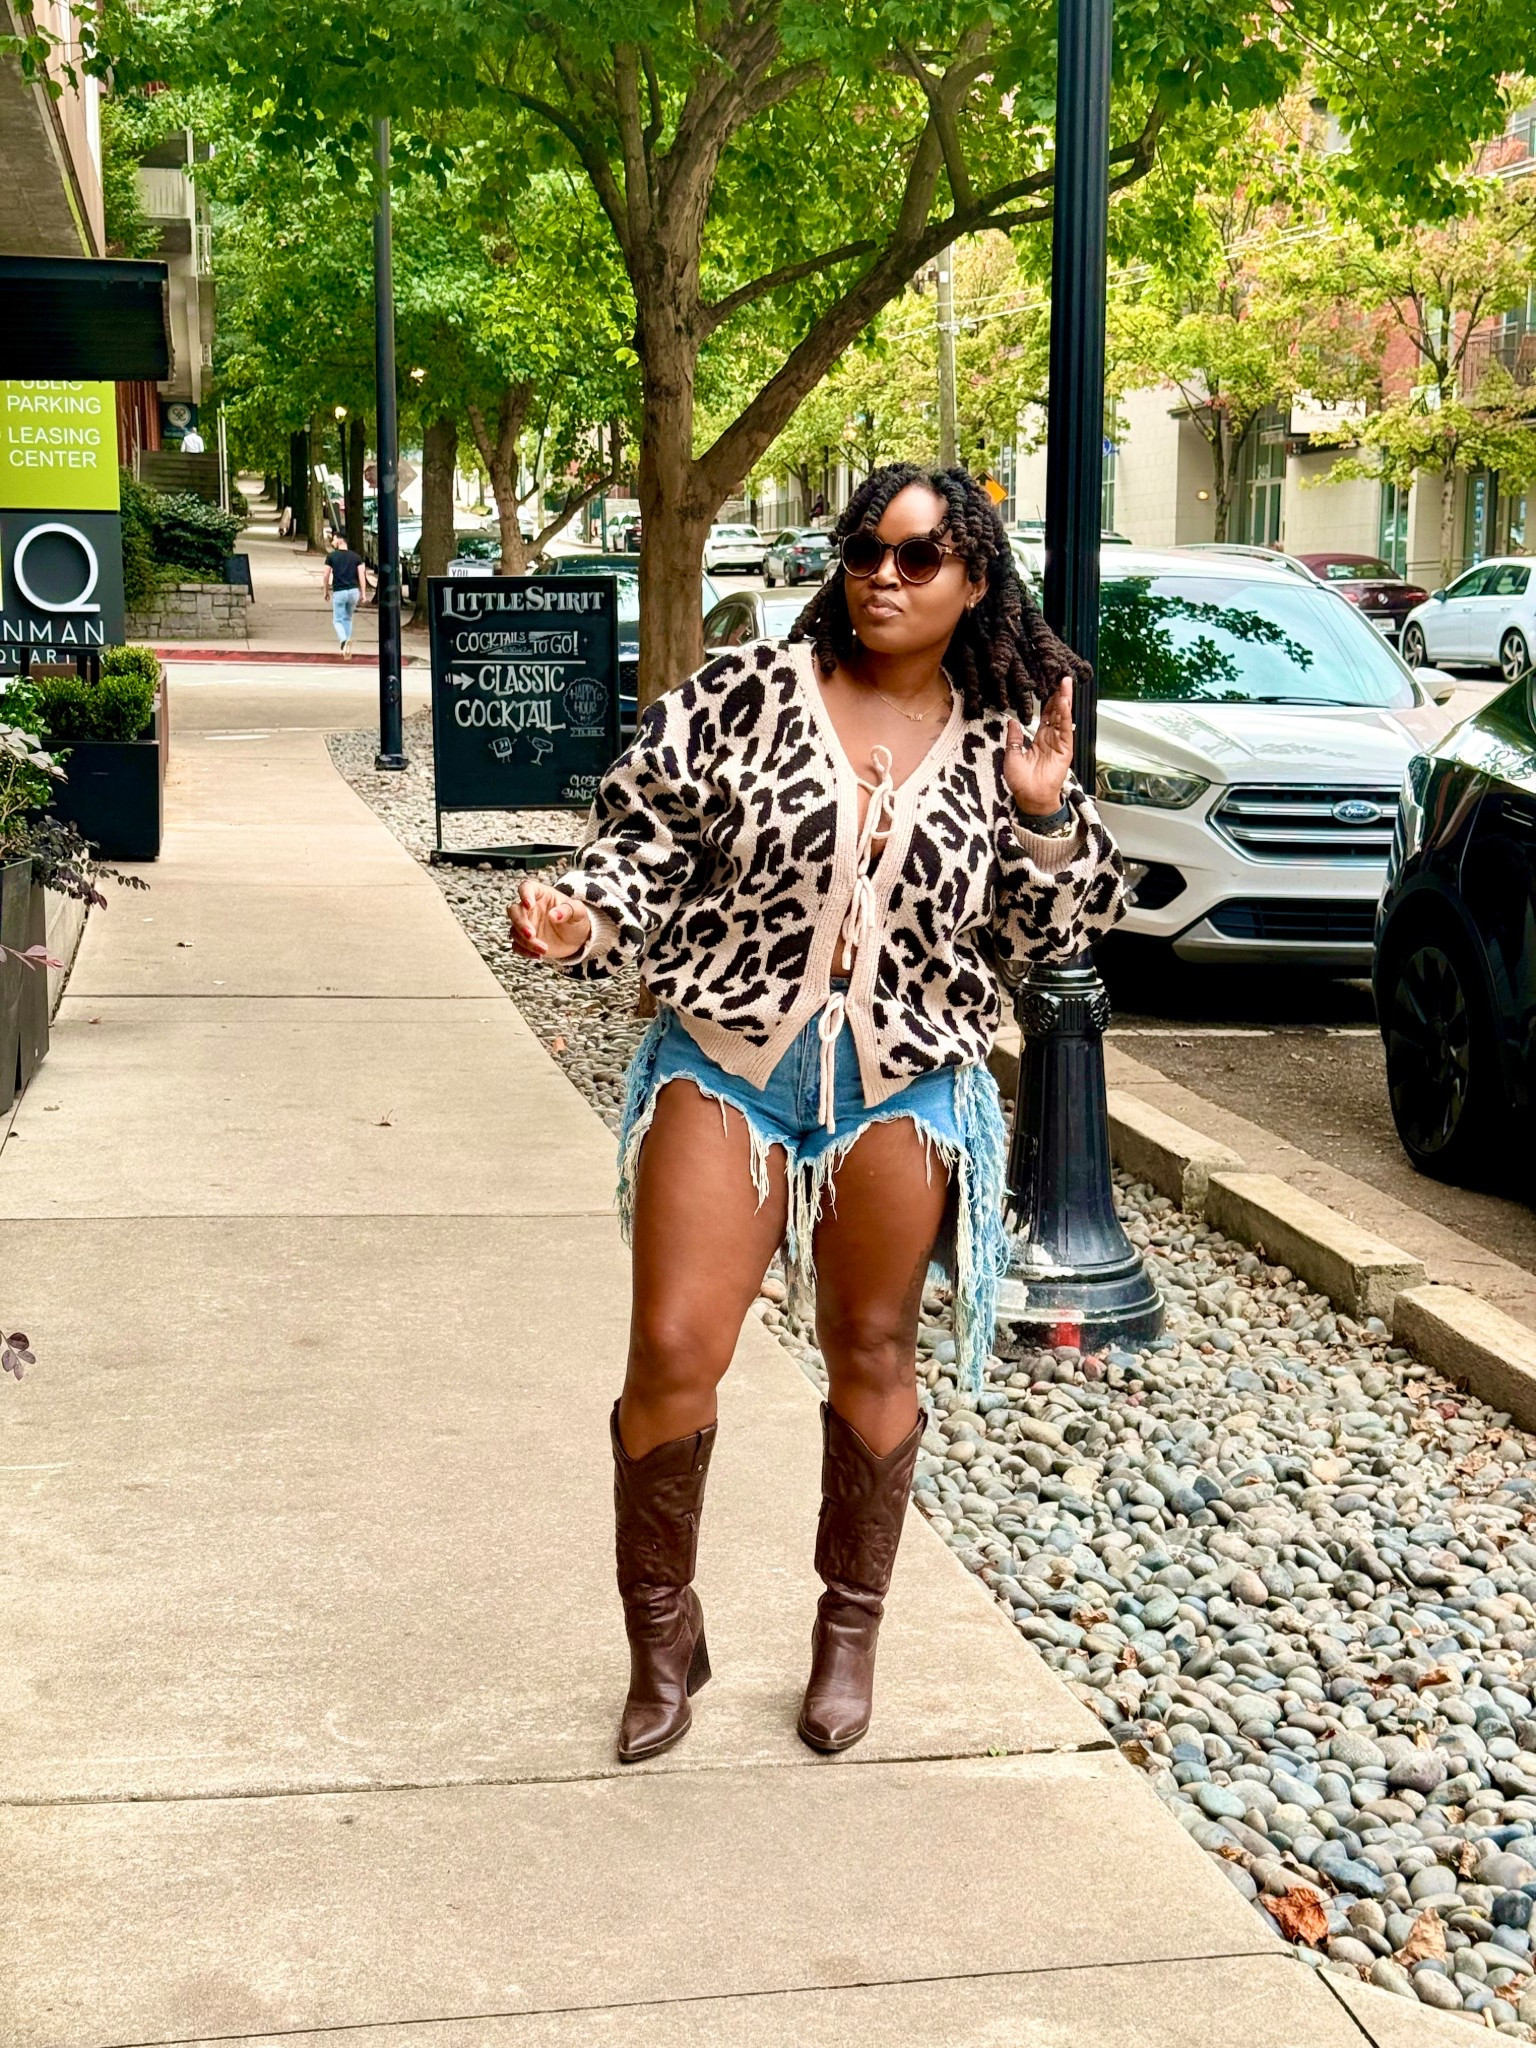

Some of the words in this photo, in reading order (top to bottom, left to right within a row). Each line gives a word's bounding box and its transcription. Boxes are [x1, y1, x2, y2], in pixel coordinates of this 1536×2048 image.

[7, 395, 101, 415] PARKING
[8, 426, 101, 446] LEASING
[9, 449, 97, 468] CENTER
[0, 619, 104, 645] NMAN
[456, 631, 527, 653] COCKTAILS
[529, 638, 549, 654] TO
[478, 664, 565, 696] CLASSIC
[570, 684, 598, 702] HAPPY
[454, 698, 567, 734] COCKTAIL
